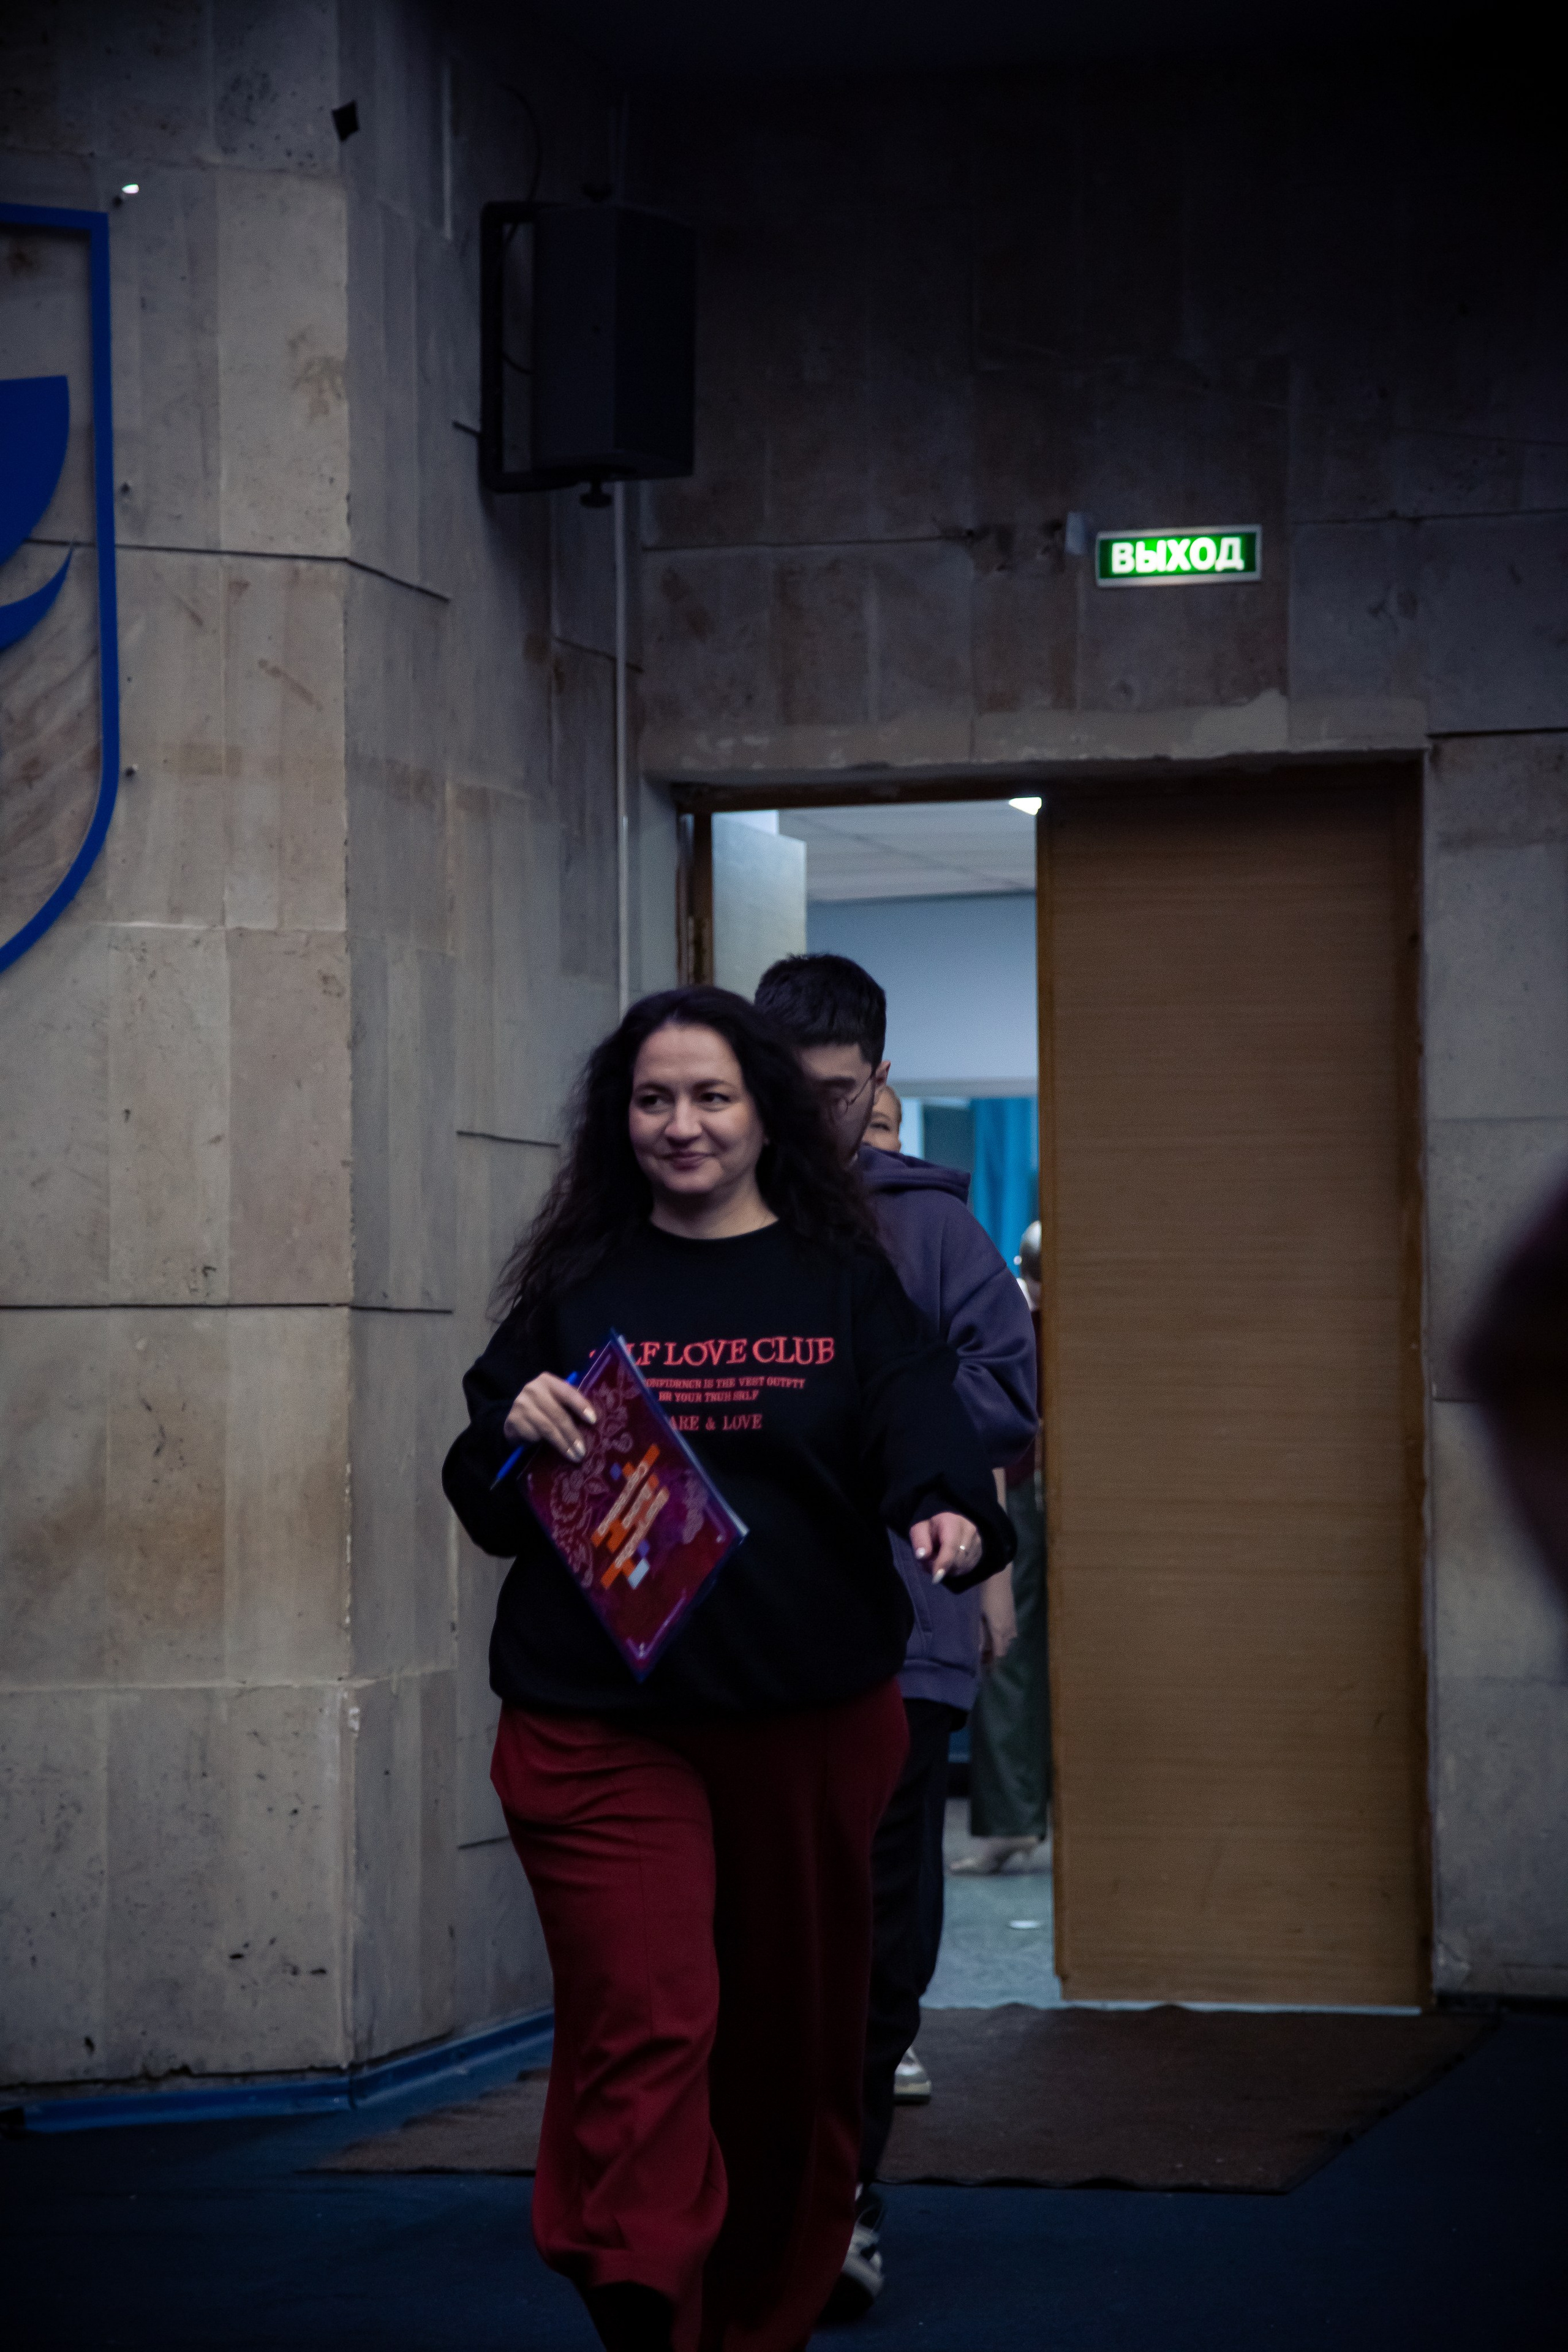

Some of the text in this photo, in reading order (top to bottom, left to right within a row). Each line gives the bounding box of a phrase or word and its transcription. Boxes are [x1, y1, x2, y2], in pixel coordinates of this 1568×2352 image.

[1111, 537, 1245, 575] ВЫХОД
[663, 1339, 748, 1366] LOVE
[752, 1336, 835, 1365] CLUB
[645, 1378, 702, 1389] ONFIDENCE
[674, 1392, 702, 1402] YOUR
[670, 1414, 763, 1431] ARE & LOVE
